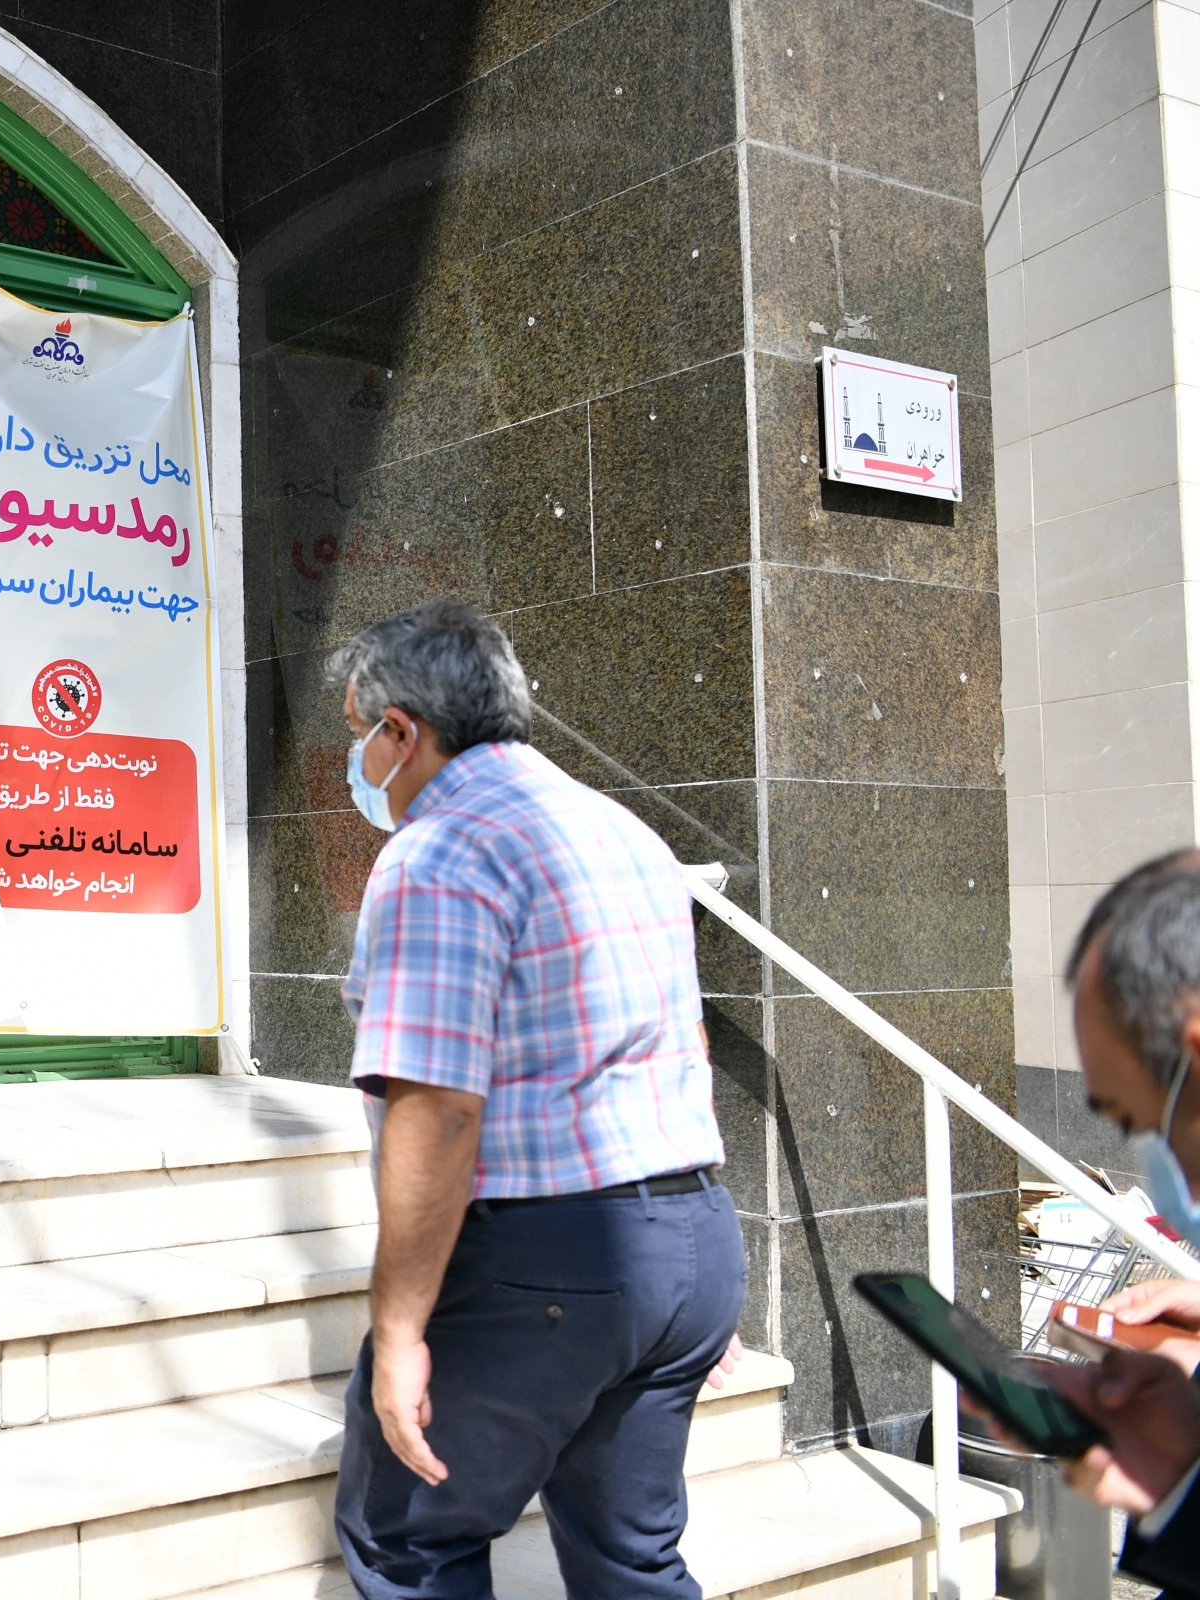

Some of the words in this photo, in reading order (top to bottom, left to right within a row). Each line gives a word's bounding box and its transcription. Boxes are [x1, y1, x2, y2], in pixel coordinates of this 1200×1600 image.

[905, 401, 942, 421] ورودی
[44, 435, 131, 474] تزریق
[140, 442, 191, 486] محل
[906, 441, 944, 468] خواهران
[39, 569, 134, 615] بیماران
[137, 586, 199, 622] جهت
[38, 705, 92, 732] COVID-19
[12, 744, 64, 771] جهت
[53, 786, 69, 812] از
[74, 787, 115, 809] فقط
[5, 827, 86, 857] تلفنی
[91, 829, 178, 857] سامانه
[15, 869, 82, 896] خواهد
[84, 871, 135, 901] انجام
